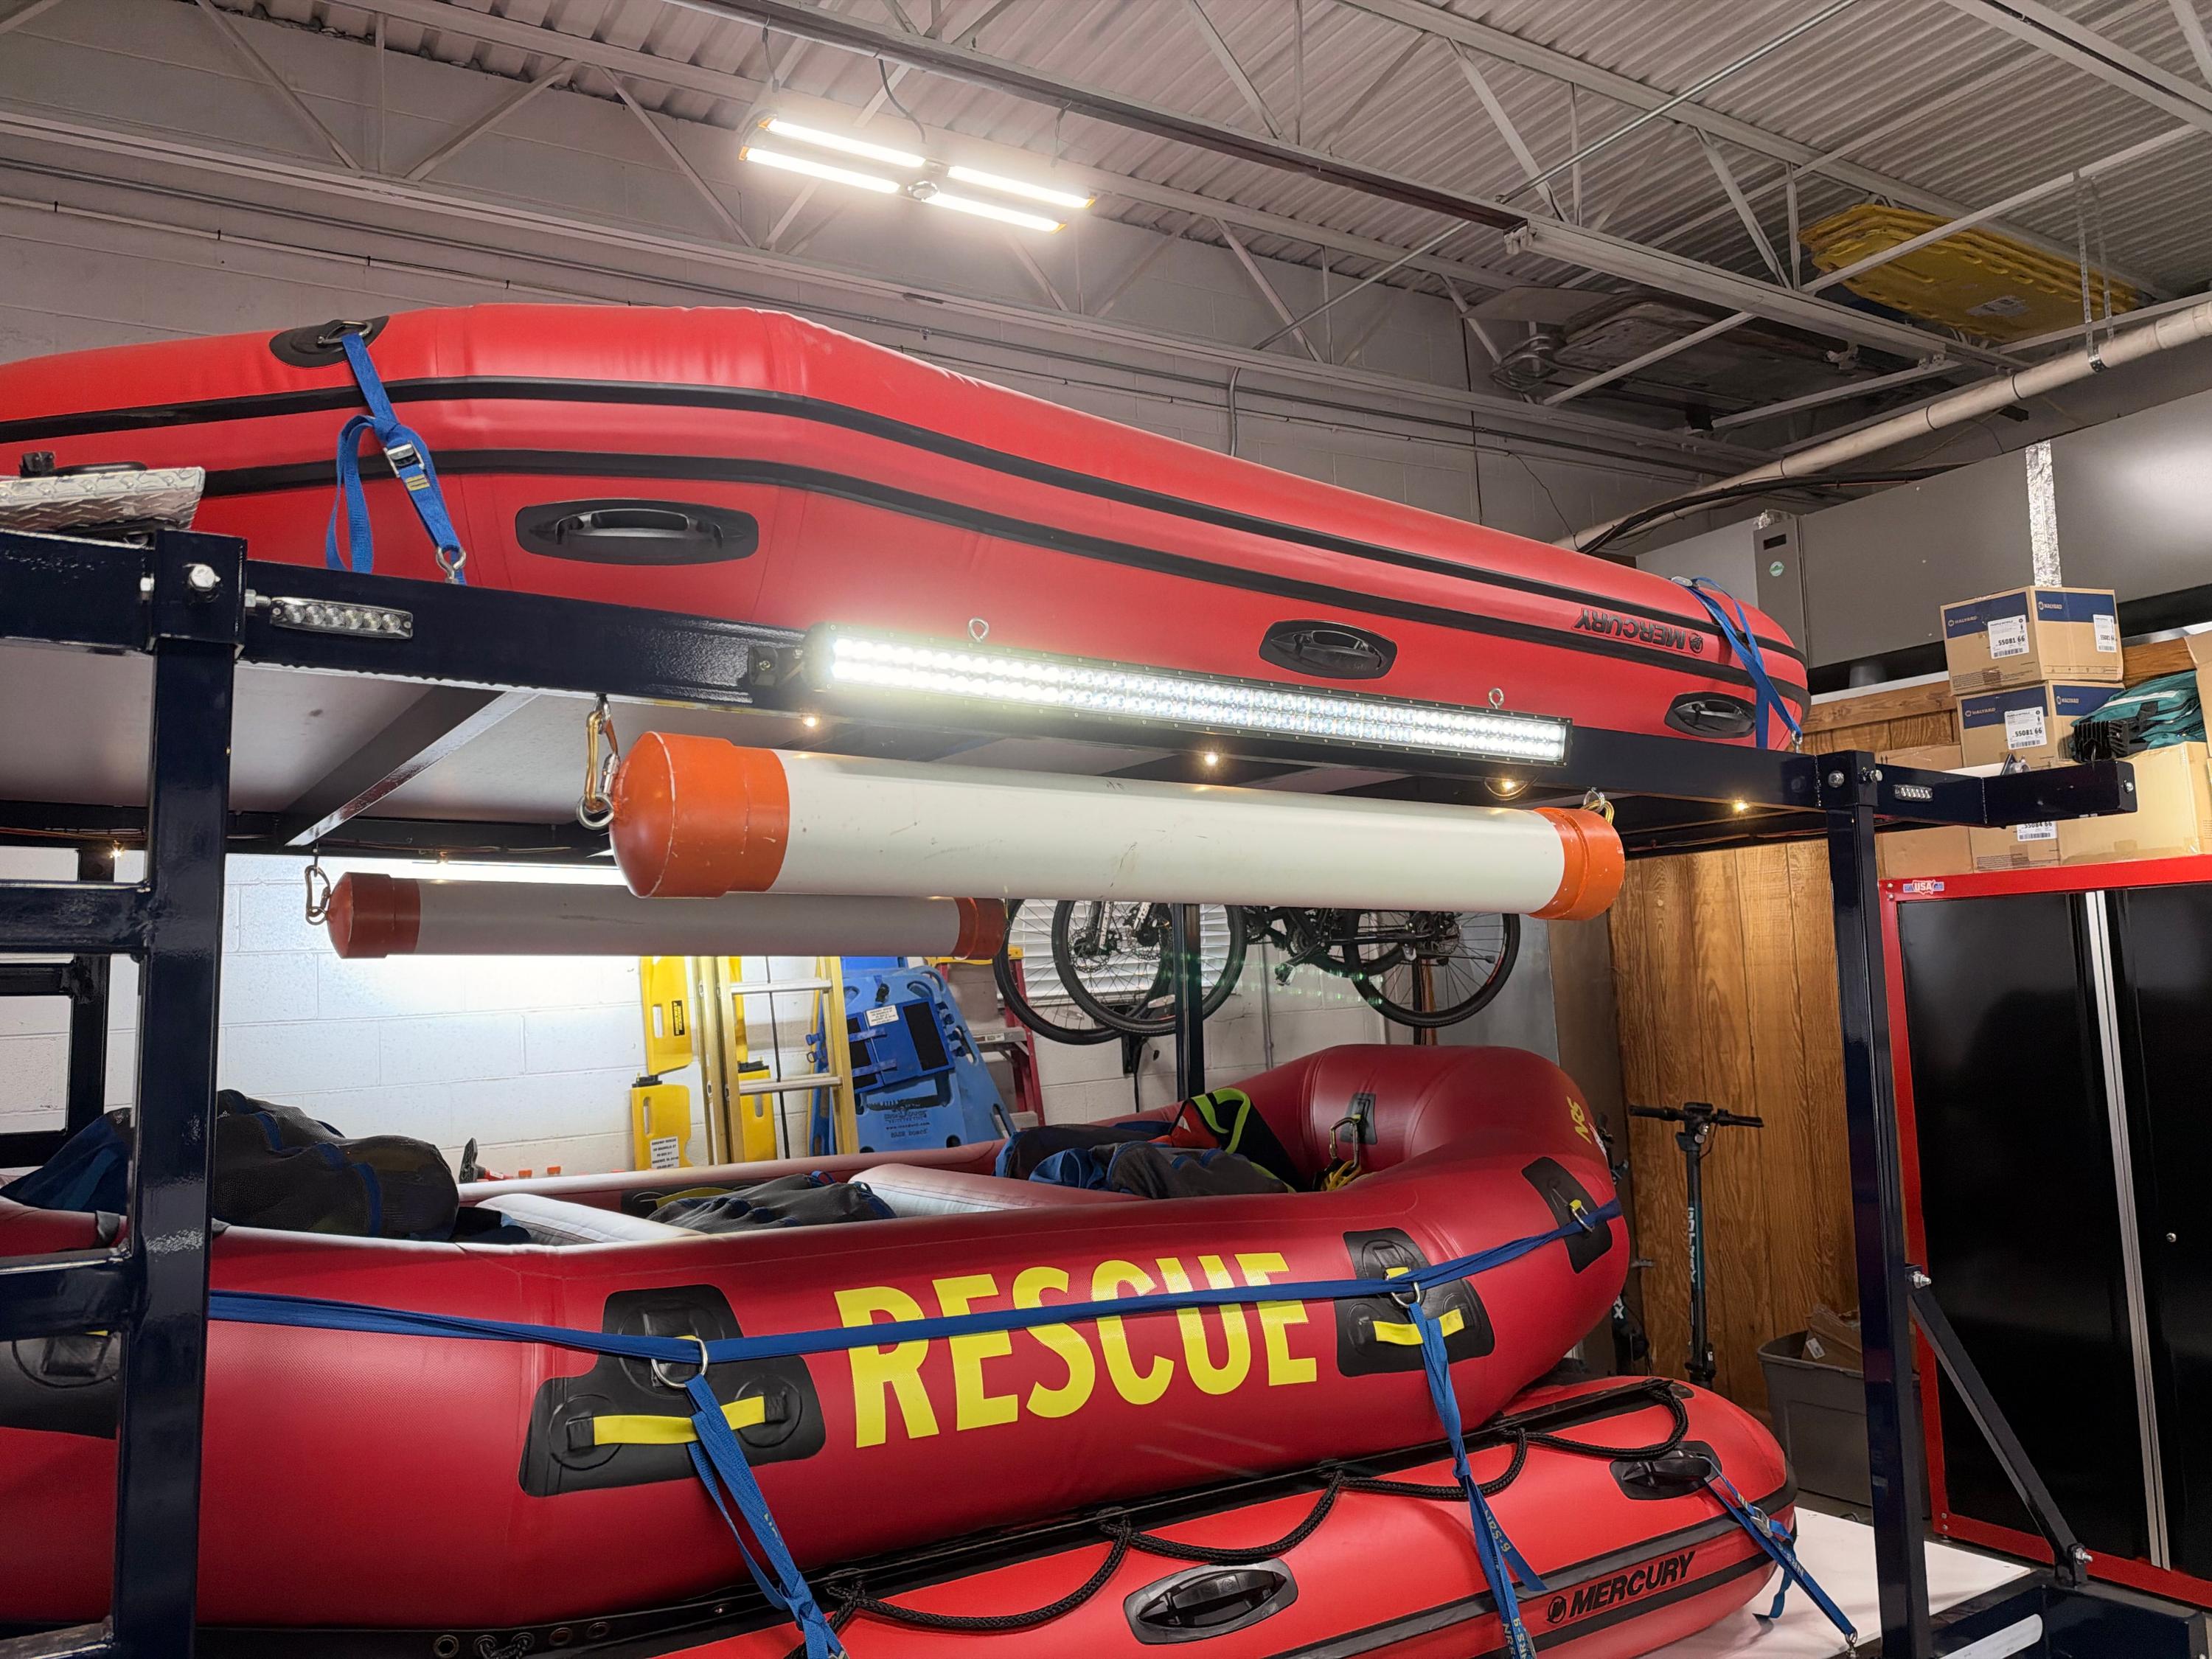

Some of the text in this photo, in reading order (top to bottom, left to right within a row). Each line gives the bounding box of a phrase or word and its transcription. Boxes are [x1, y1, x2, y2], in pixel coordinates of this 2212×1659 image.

[1955, 615, 1978, 625] HALYARD
[1573, 608, 1686, 650] MERCURY
[1998, 637, 2016, 646] 55081
[1972, 706, 1996, 715] HALYARD
[2015, 728, 2033, 737] 55081
[1913, 881, 1933, 891] USA
[1566, 1096, 1592, 1144] NRS
[834, 1252, 1316, 1448] RESCUE
[1569, 1551, 1696, 1618] MERCURY
